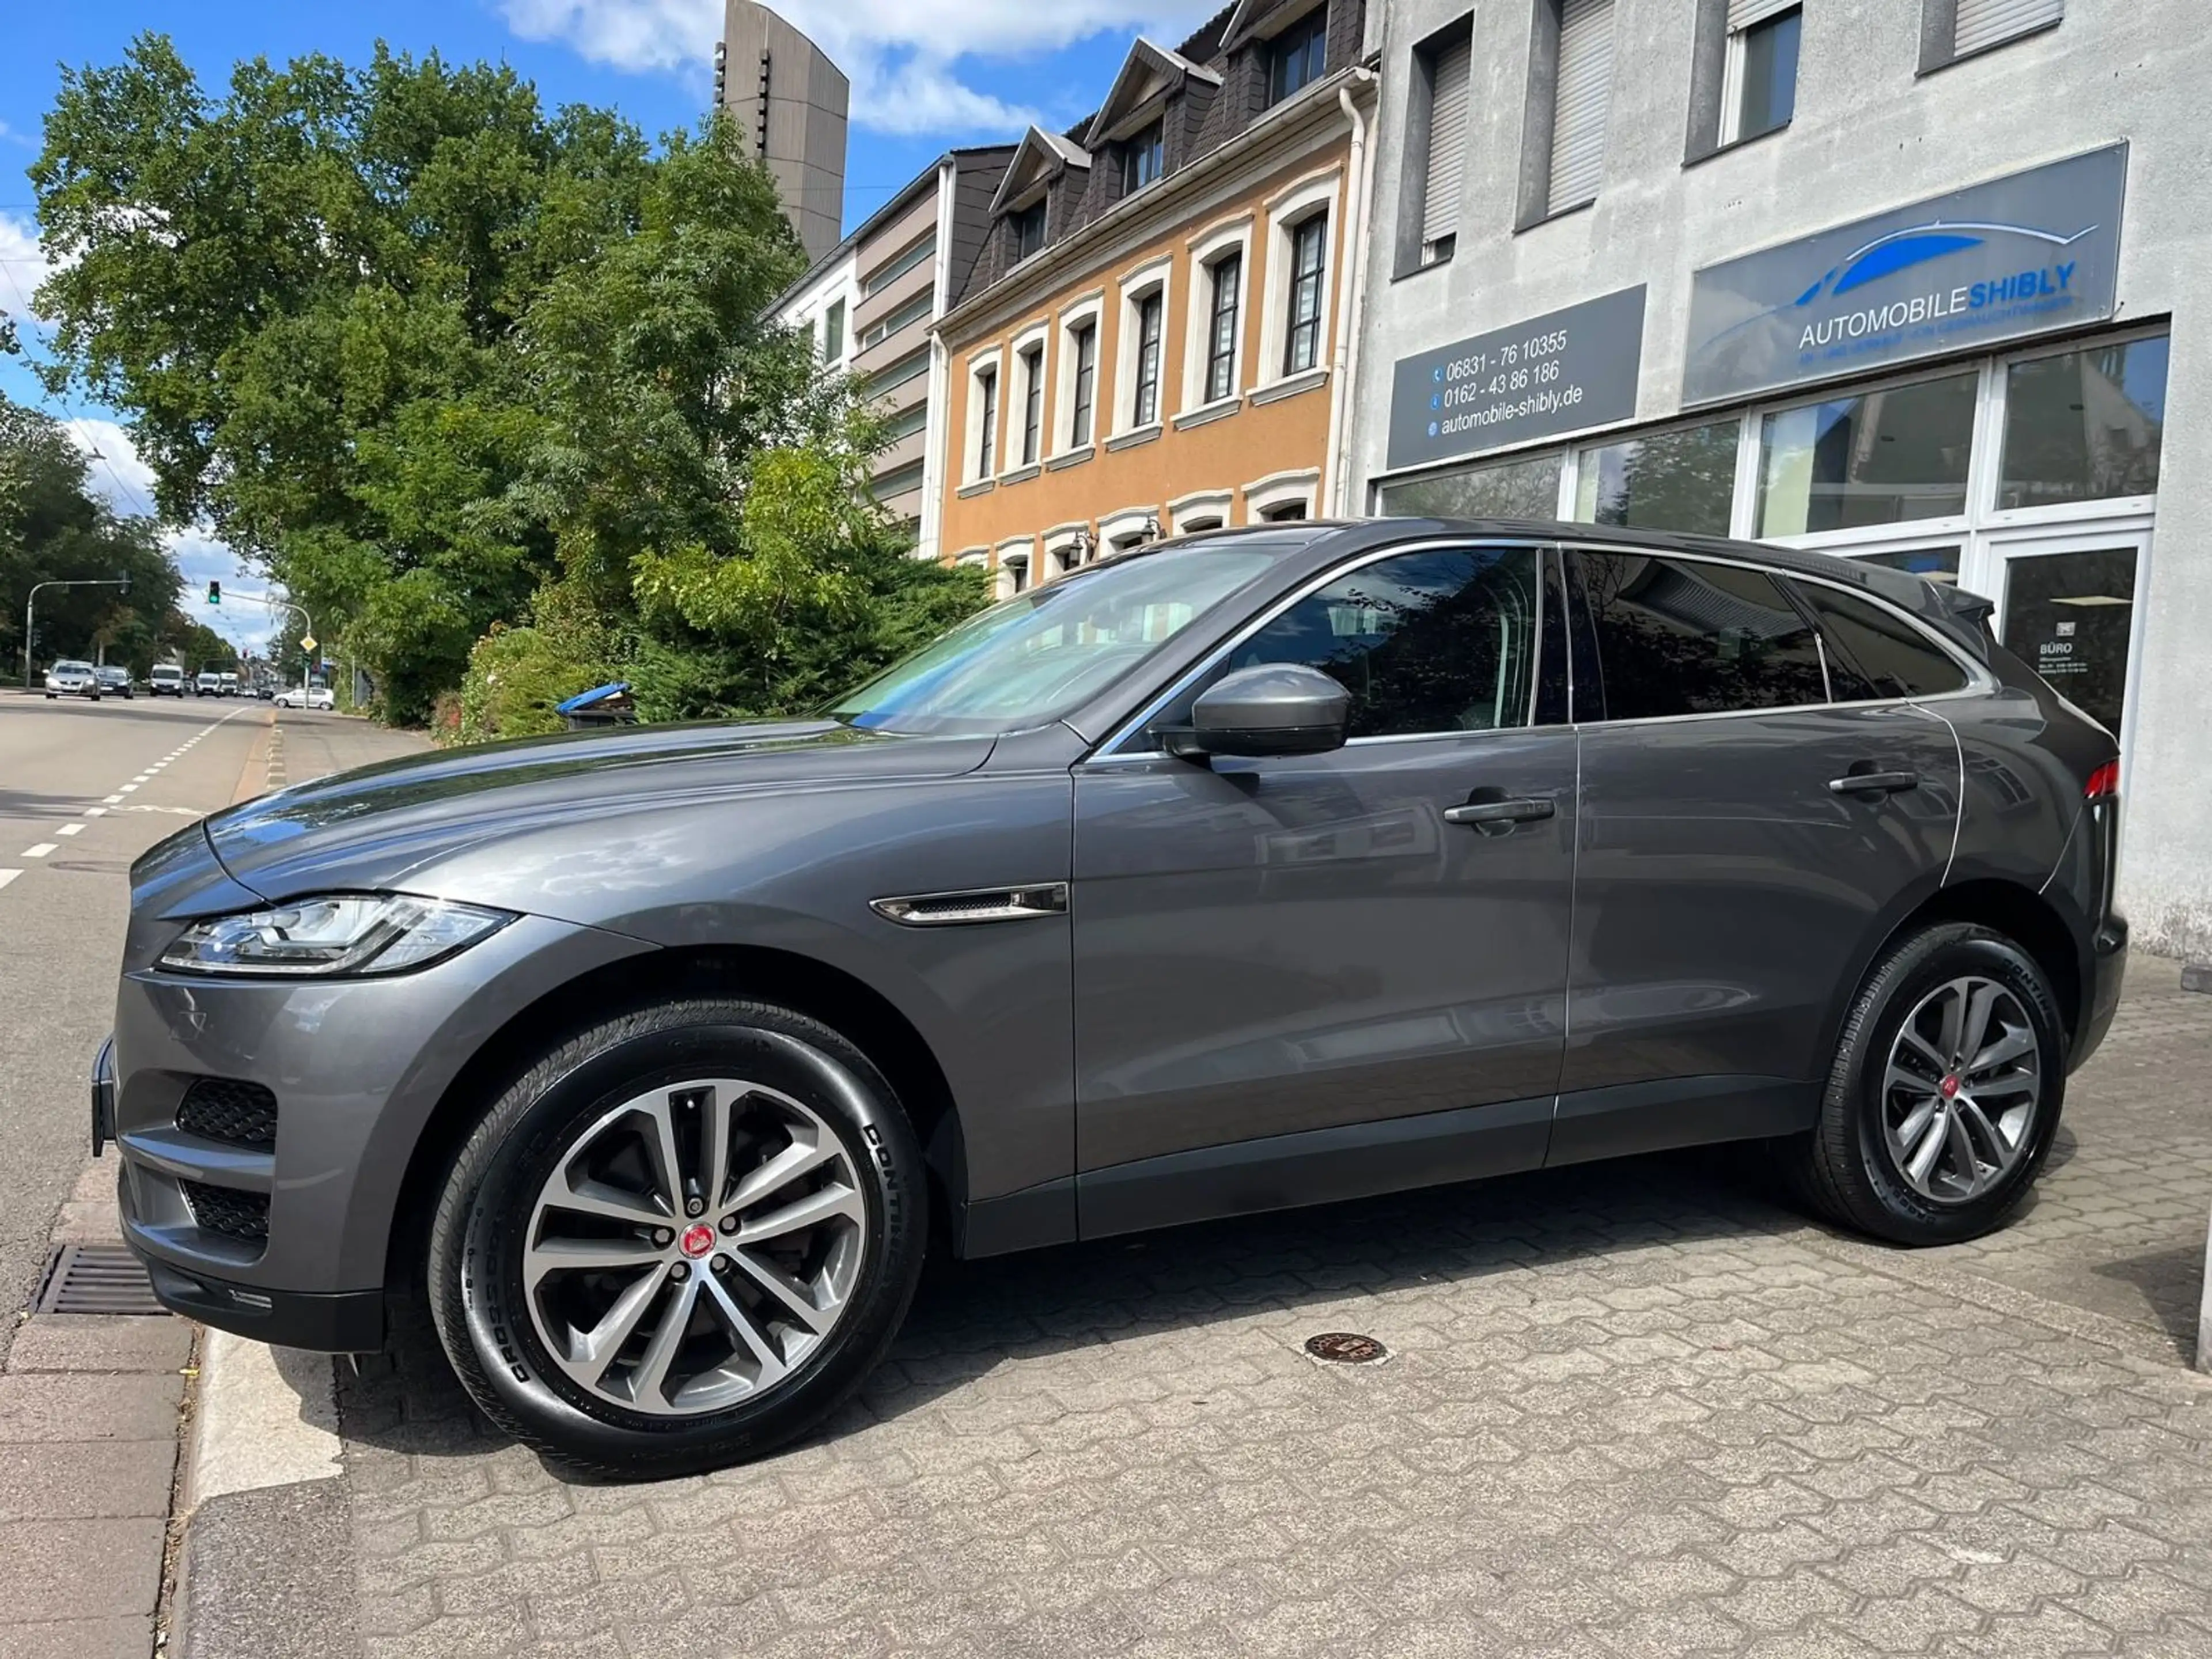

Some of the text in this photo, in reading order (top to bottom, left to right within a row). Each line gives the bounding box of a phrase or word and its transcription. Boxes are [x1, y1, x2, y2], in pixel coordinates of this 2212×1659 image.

[1446, 354, 1486, 382] 06831
[1500, 345, 1518, 368] 76
[1522, 329, 1567, 362] 10355
[1444, 381, 1476, 408] 0162
[1488, 372, 1507, 395] 43
[1509, 368, 1528, 389] 86
[1533, 359, 1560, 385] 186
[1441, 384, 1583, 435] automobile-shibly.de
[2040, 641, 2073, 654] BÜRO
